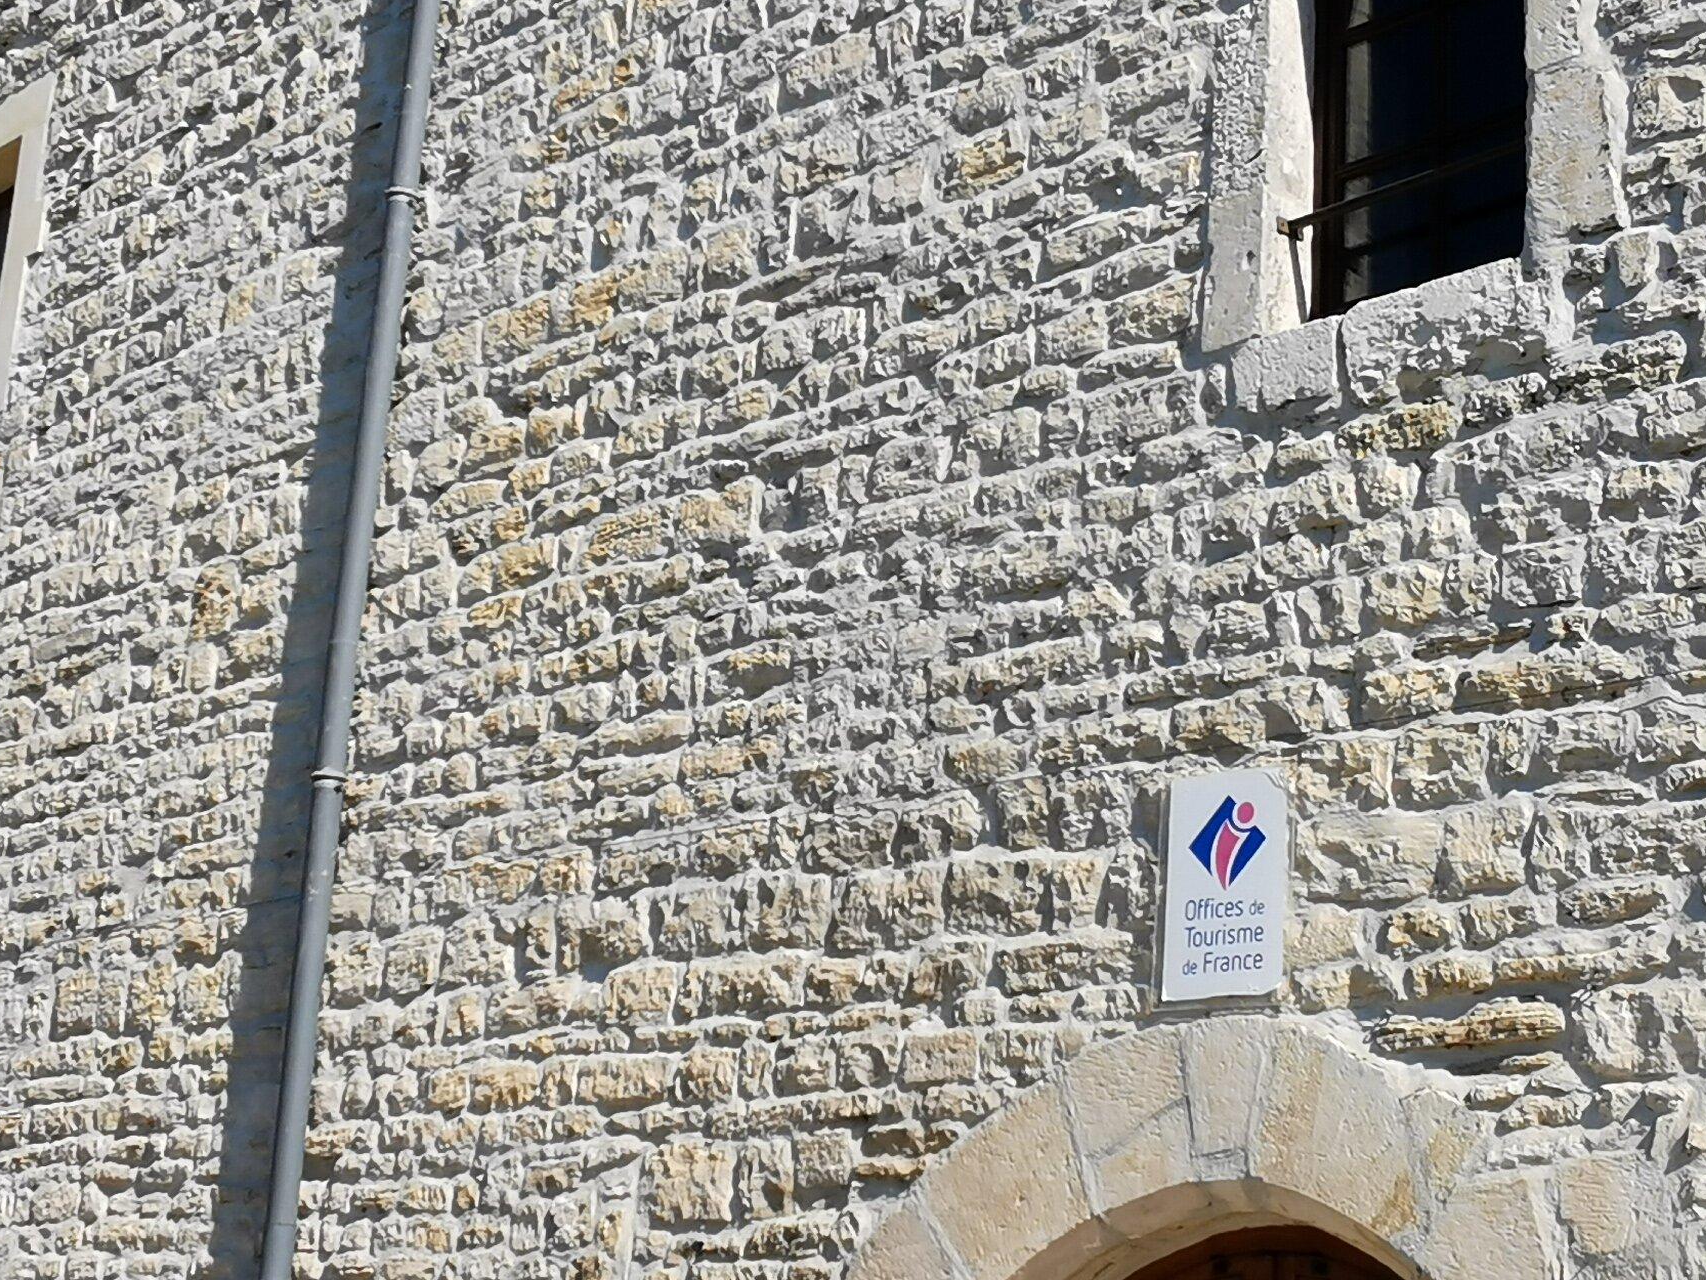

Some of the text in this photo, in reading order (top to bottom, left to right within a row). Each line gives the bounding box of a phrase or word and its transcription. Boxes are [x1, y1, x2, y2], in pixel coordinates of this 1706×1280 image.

[1185, 898, 1266, 922] Offices de
[1185, 924, 1264, 949] Tourisme
[1182, 952, 1264, 976] de France
